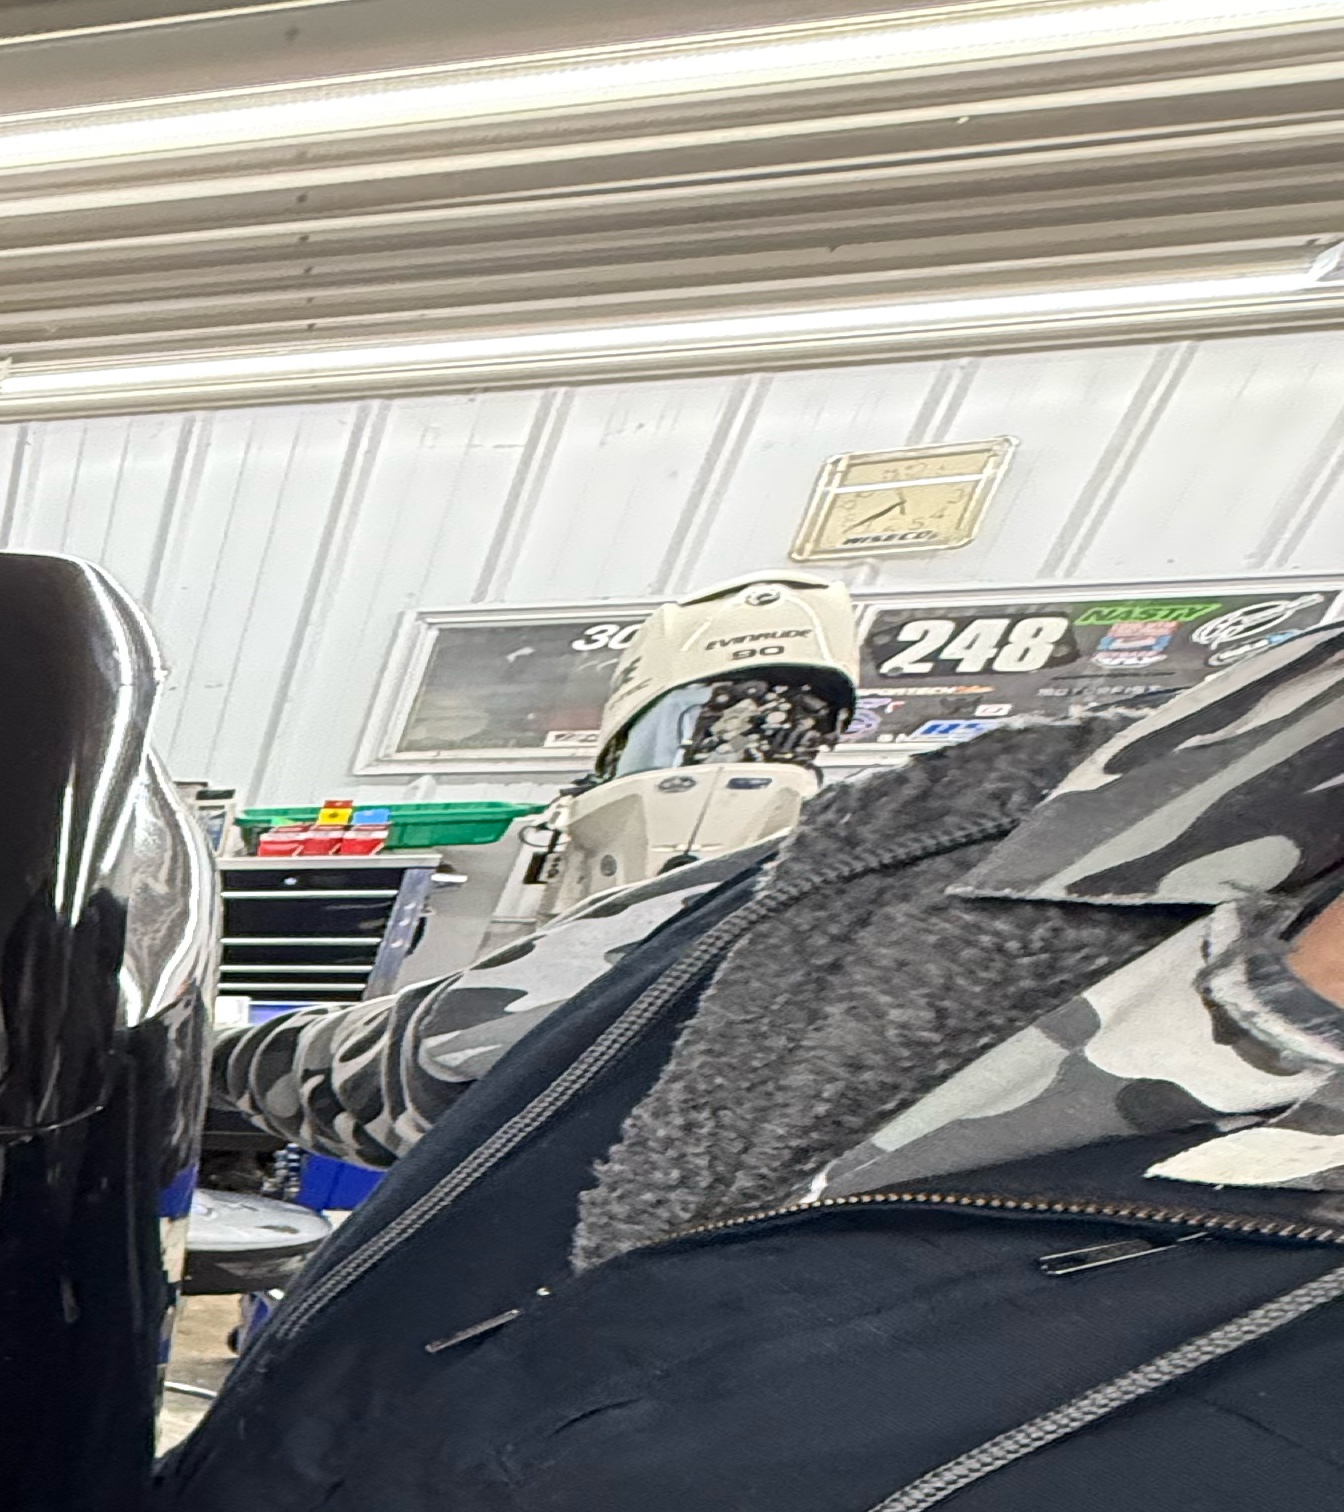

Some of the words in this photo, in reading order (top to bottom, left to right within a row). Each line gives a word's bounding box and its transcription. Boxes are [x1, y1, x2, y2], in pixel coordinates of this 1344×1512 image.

[1082, 604, 1214, 623] NASTY
[705, 628, 813, 651] EVINRUDE
[879, 616, 1069, 674] 248
[730, 645, 785, 661] 90
